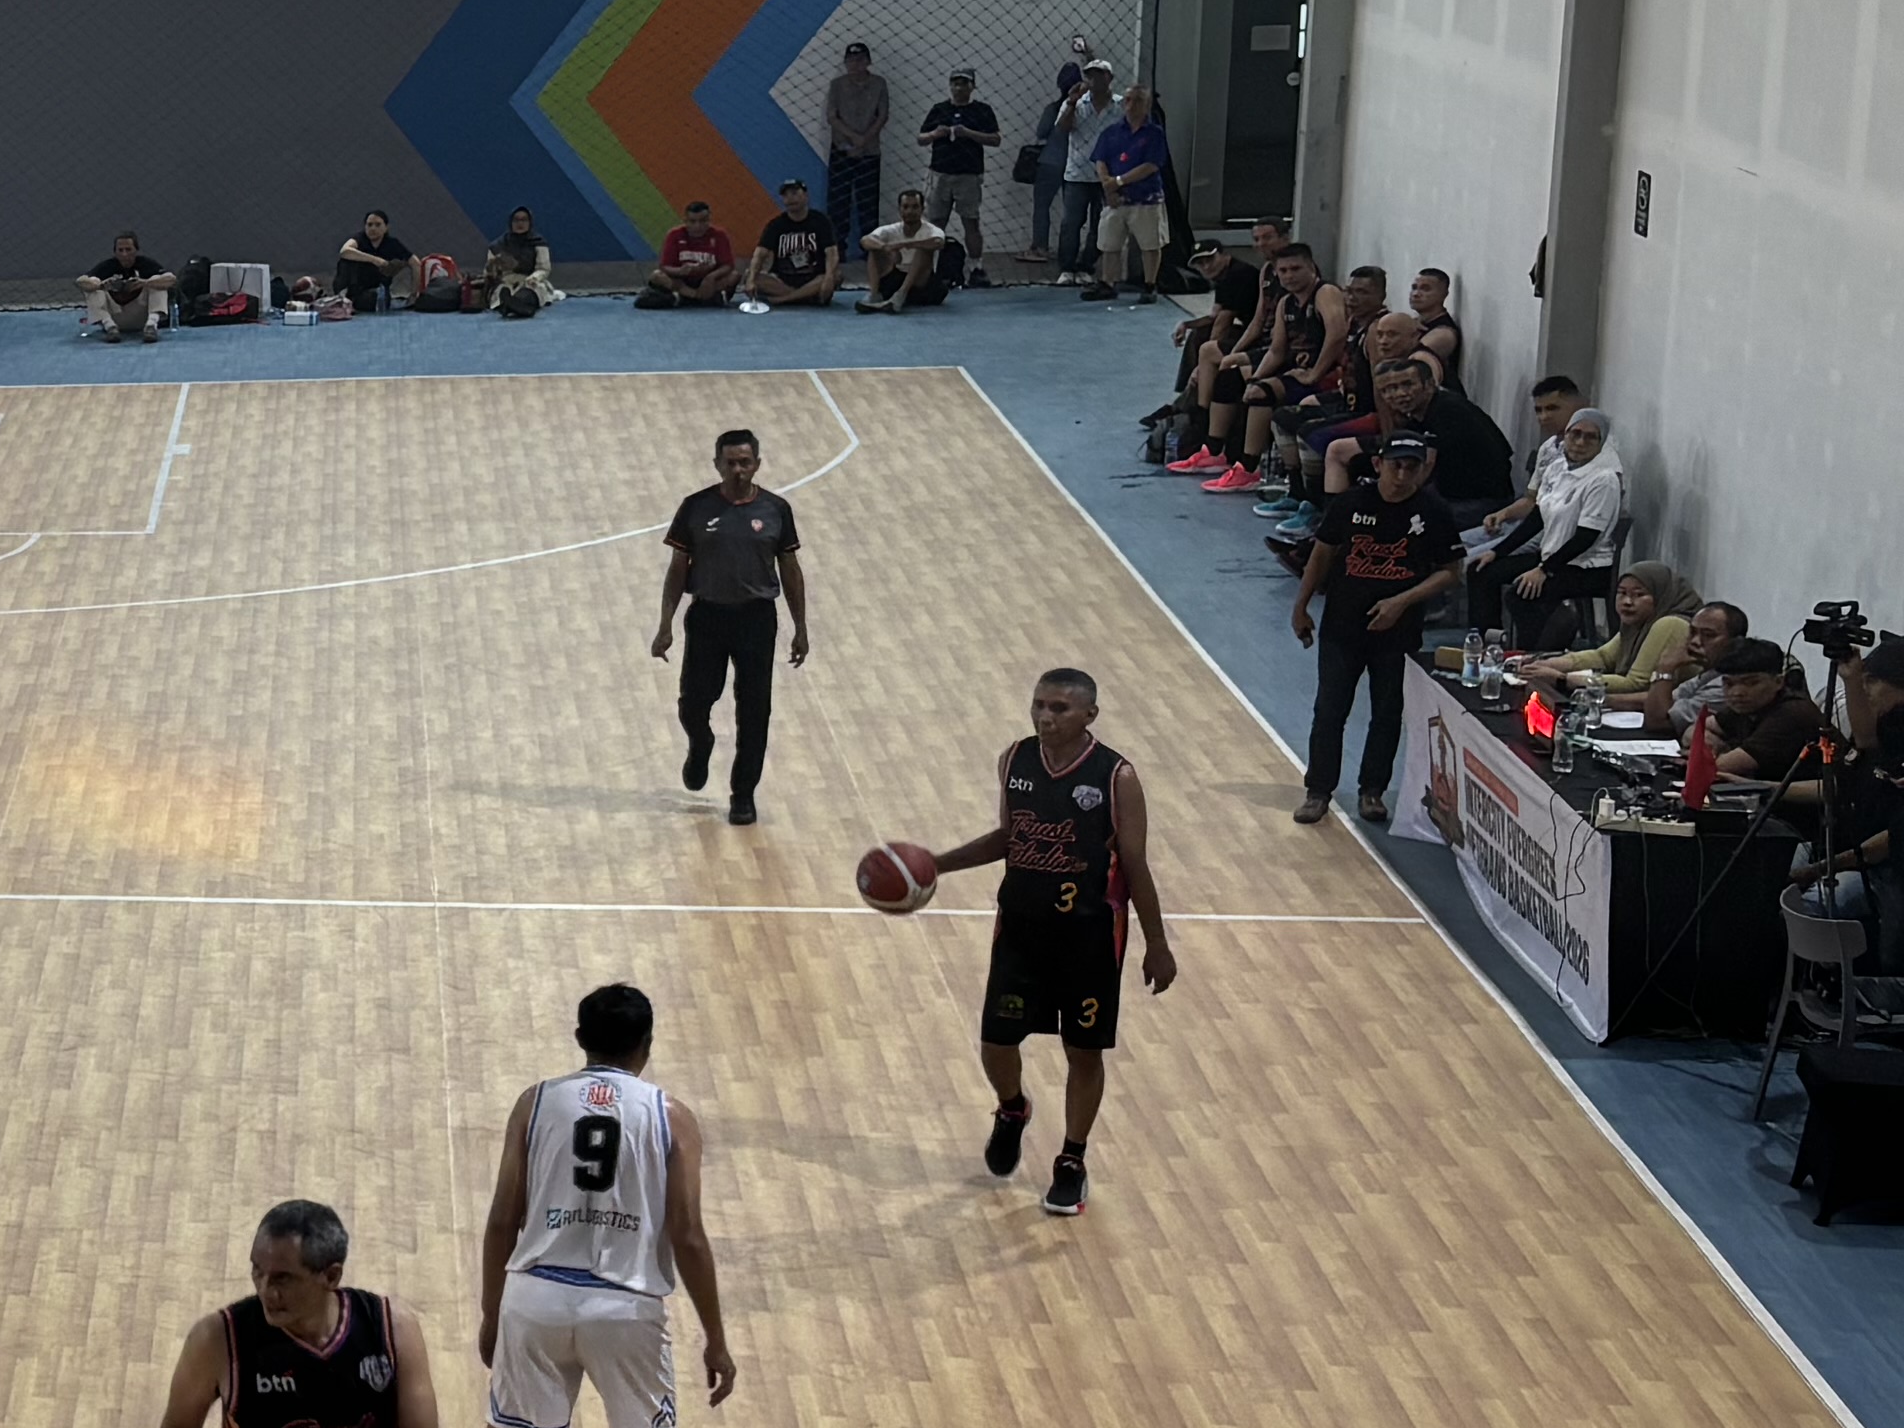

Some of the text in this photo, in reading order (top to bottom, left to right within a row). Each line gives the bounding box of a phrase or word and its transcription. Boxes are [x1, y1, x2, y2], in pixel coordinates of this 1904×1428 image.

[1054, 881, 1079, 913] 3
[1077, 997, 1099, 1029] 3
[572, 1115, 622, 1193] 9
[256, 1372, 297, 1394] btn
